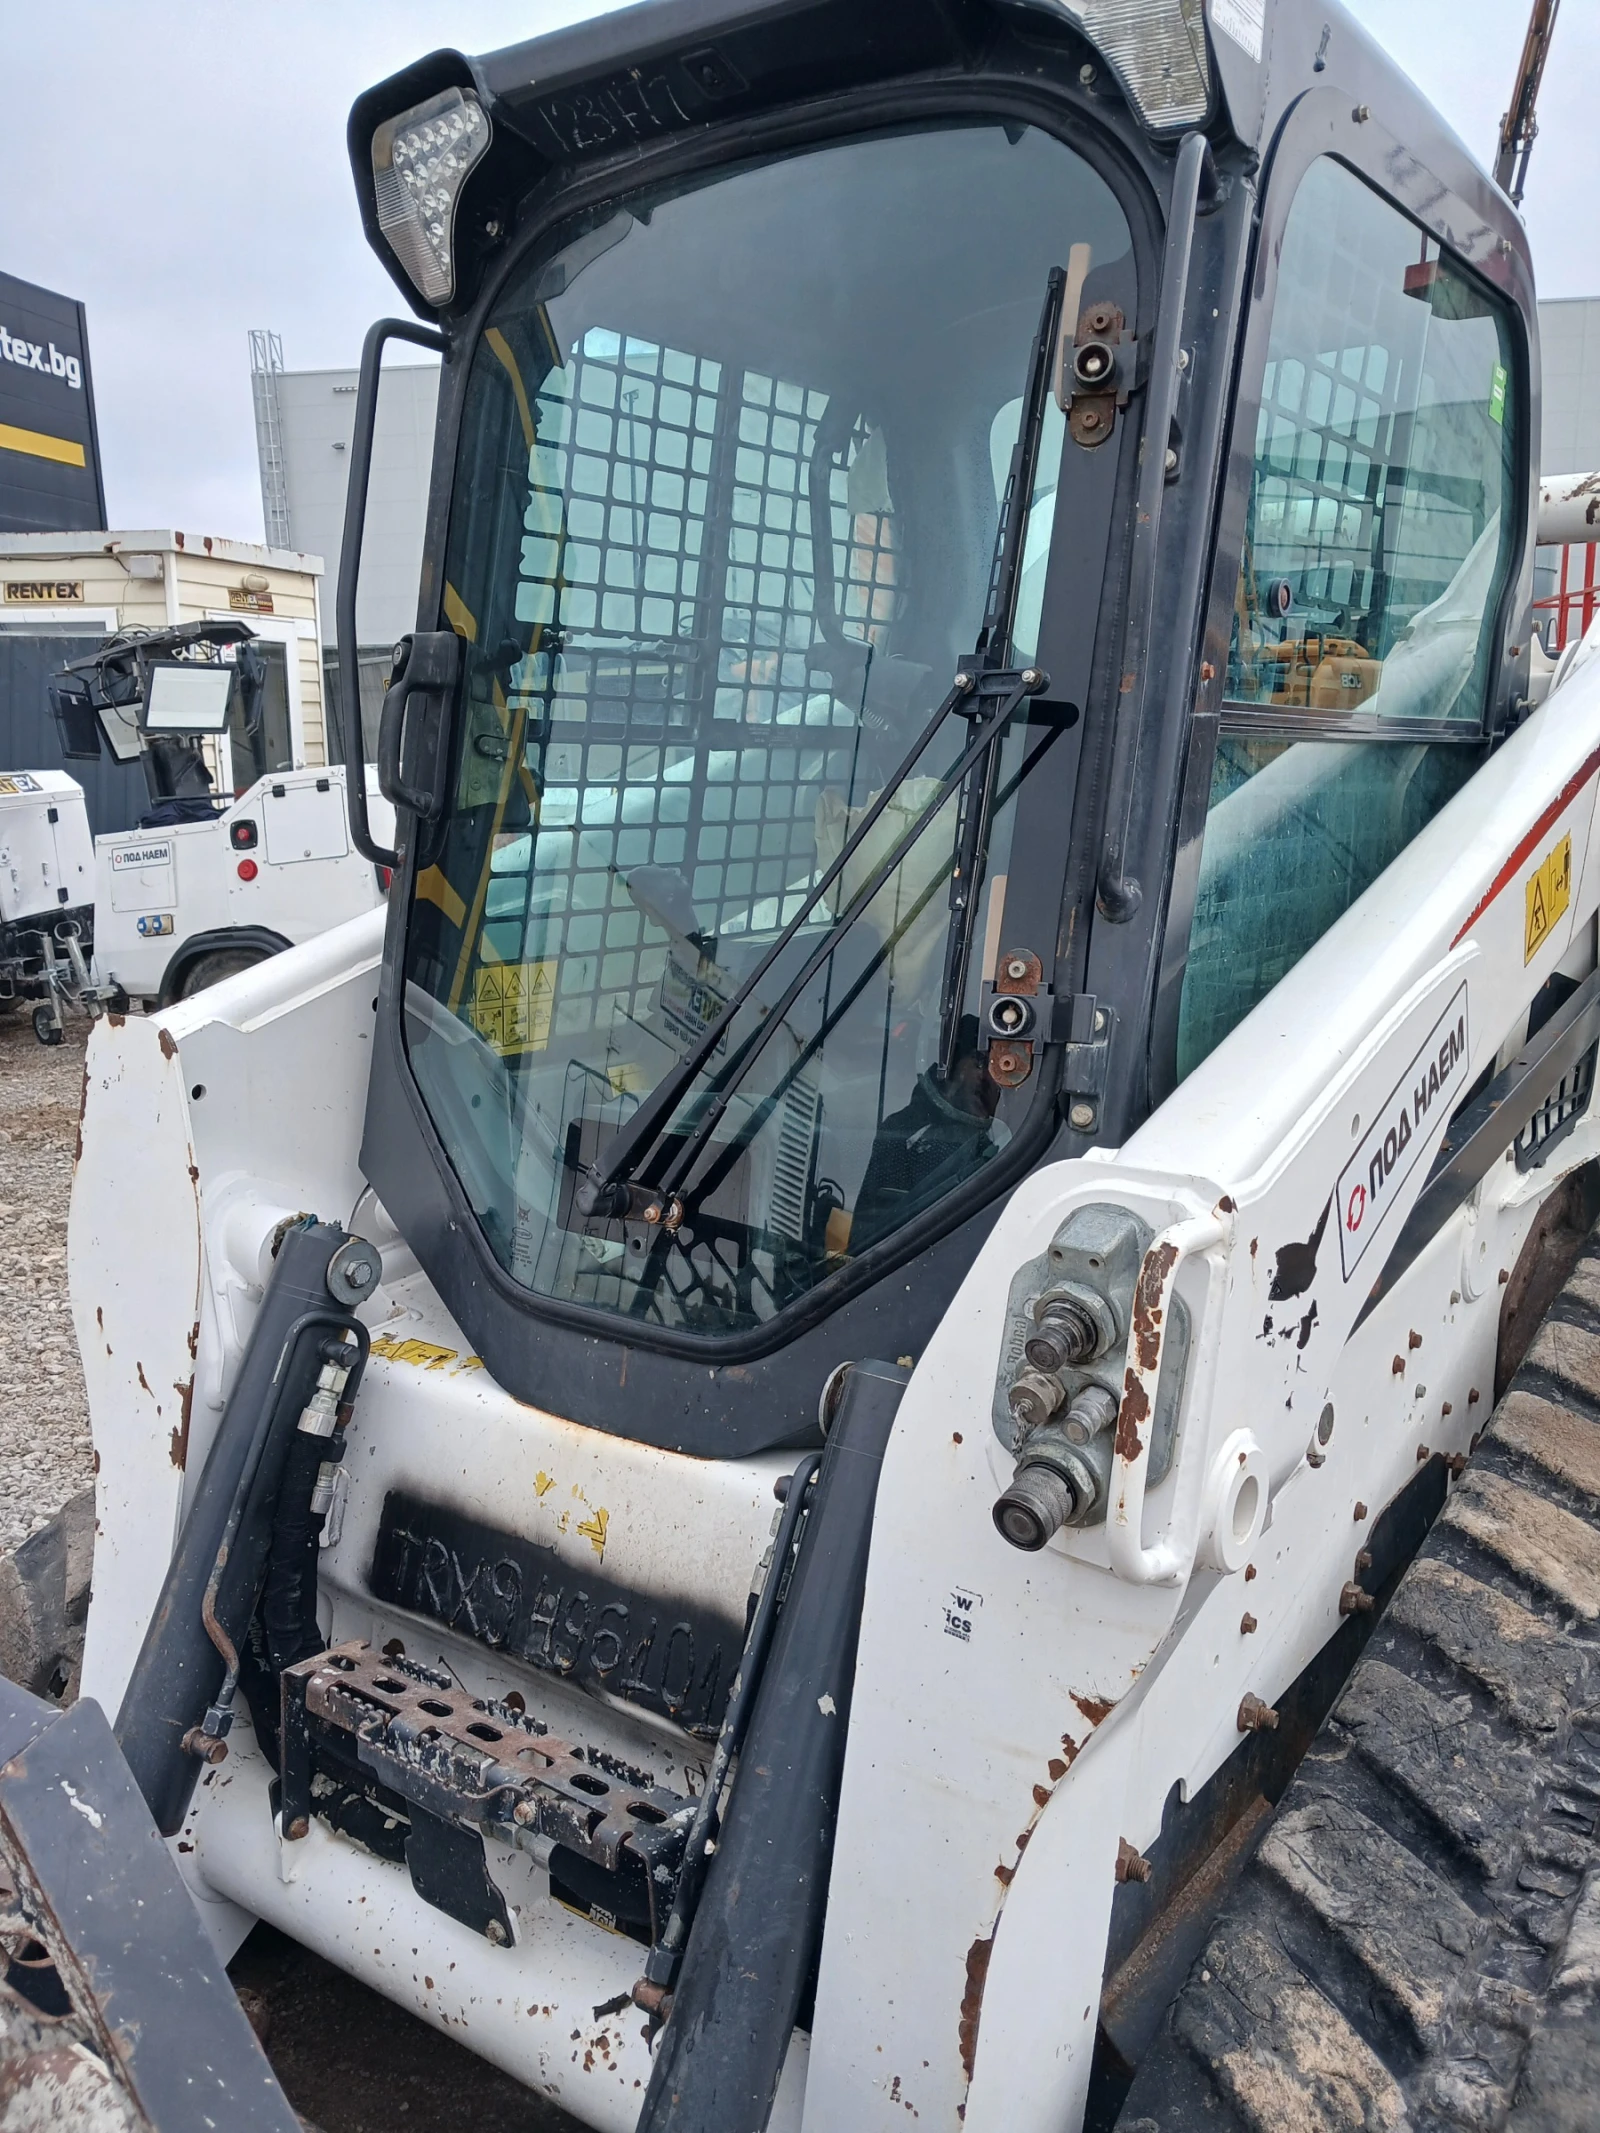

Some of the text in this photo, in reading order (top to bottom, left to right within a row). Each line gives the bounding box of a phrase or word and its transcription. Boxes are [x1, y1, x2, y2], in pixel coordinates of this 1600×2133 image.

[0, 325, 81, 389] tex.bg
[7, 582, 79, 599] RENTEX
[123, 848, 168, 863] ПОД НАЕМ
[1369, 1015, 1465, 1204] ПОД НАЕМ
